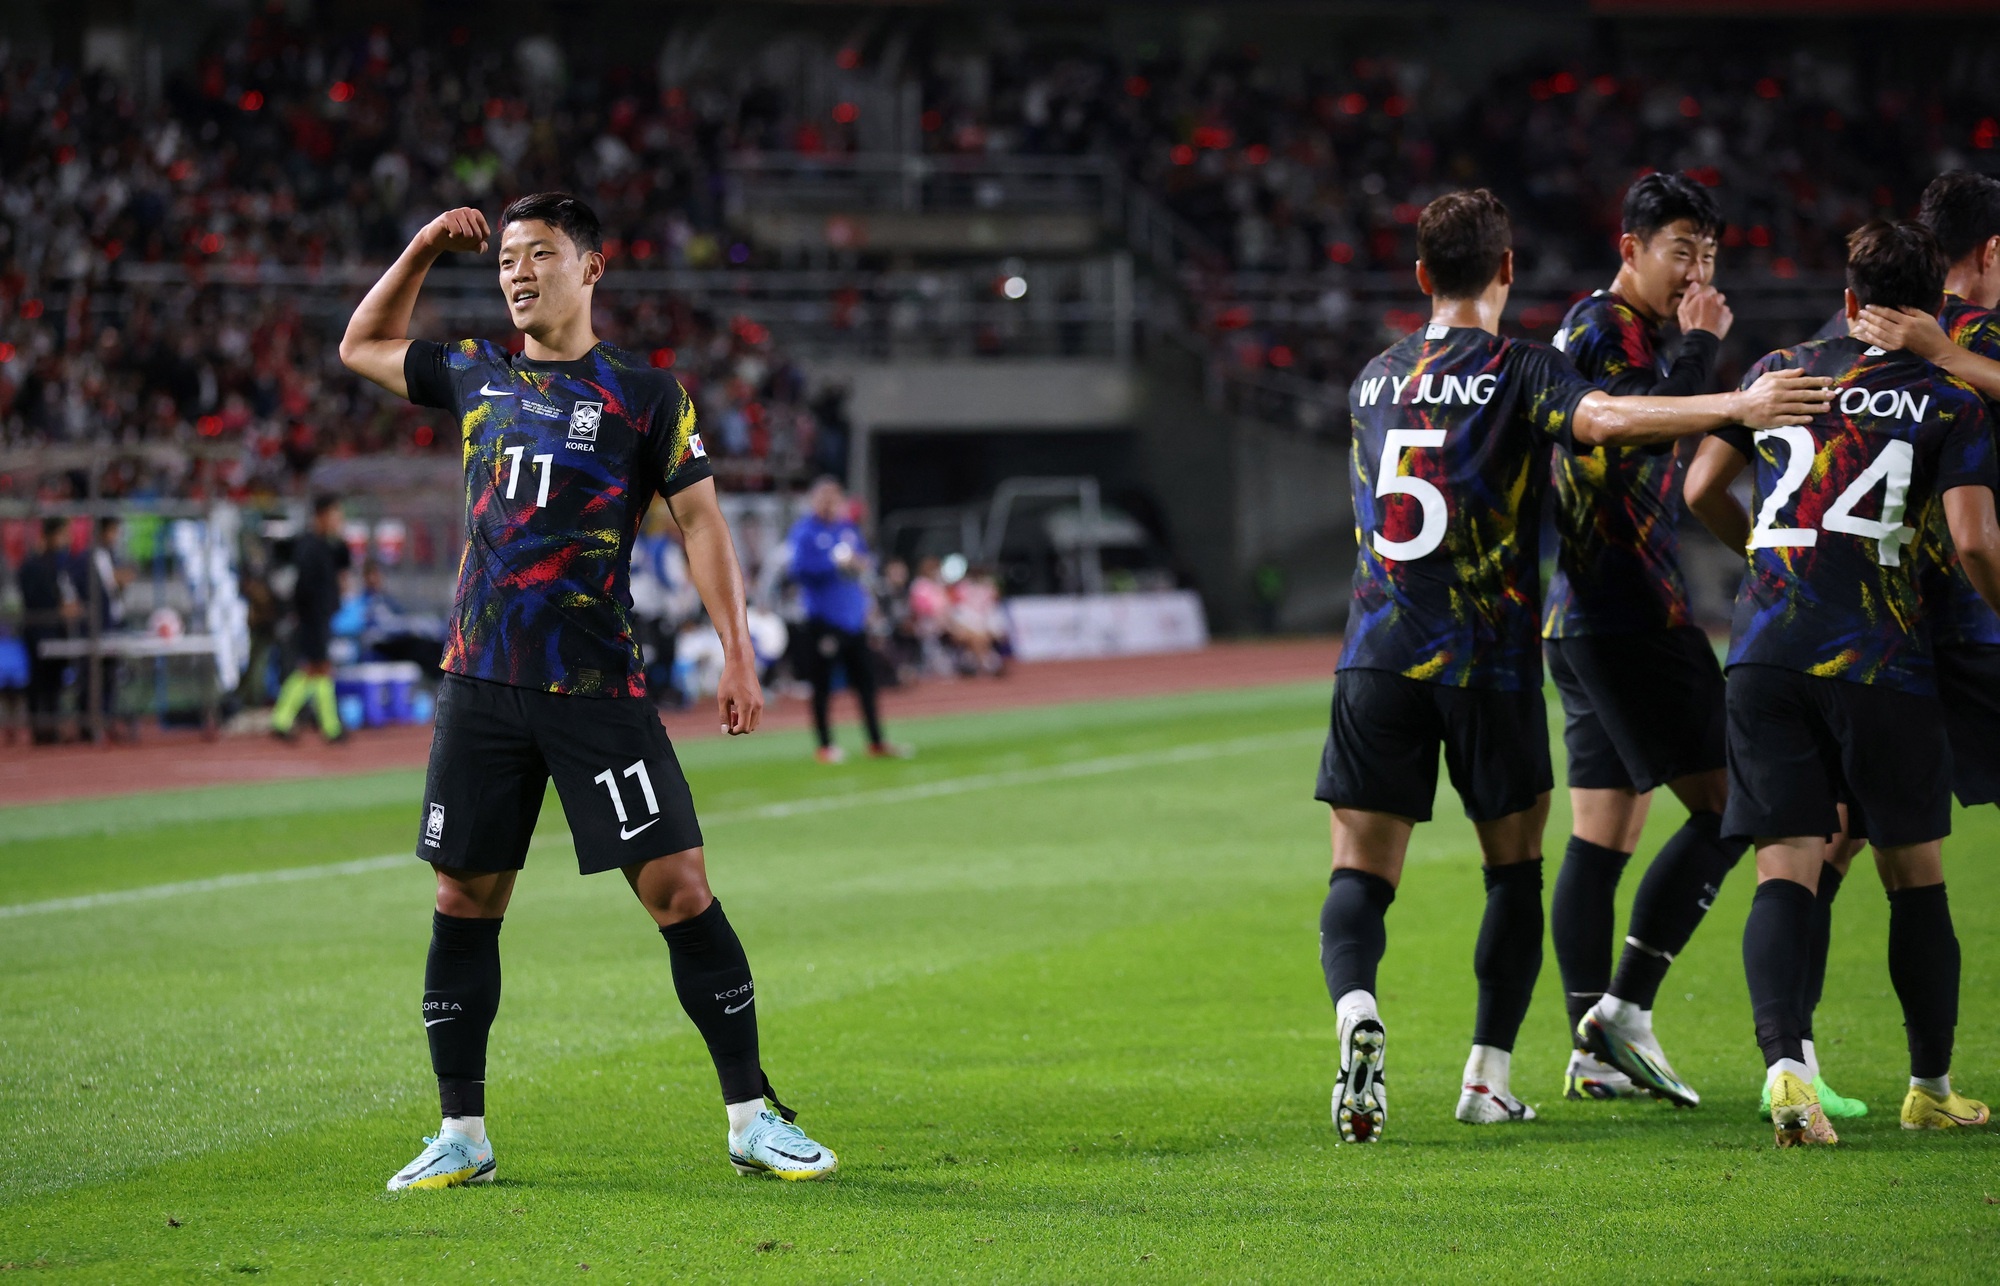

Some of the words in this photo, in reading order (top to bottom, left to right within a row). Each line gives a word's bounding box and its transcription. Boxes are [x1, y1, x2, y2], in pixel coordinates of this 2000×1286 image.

[1359, 375, 1387, 407] W
[1391, 375, 1411, 405] Y
[1411, 373, 1497, 405] JUNG
[503, 445, 554, 508] 11
[565, 441, 595, 452] KOREA
[1372, 428, 1449, 562] 5
[1745, 425, 1916, 567] 24
[594, 759, 660, 823] 11
[421, 1001, 462, 1011] OREA
